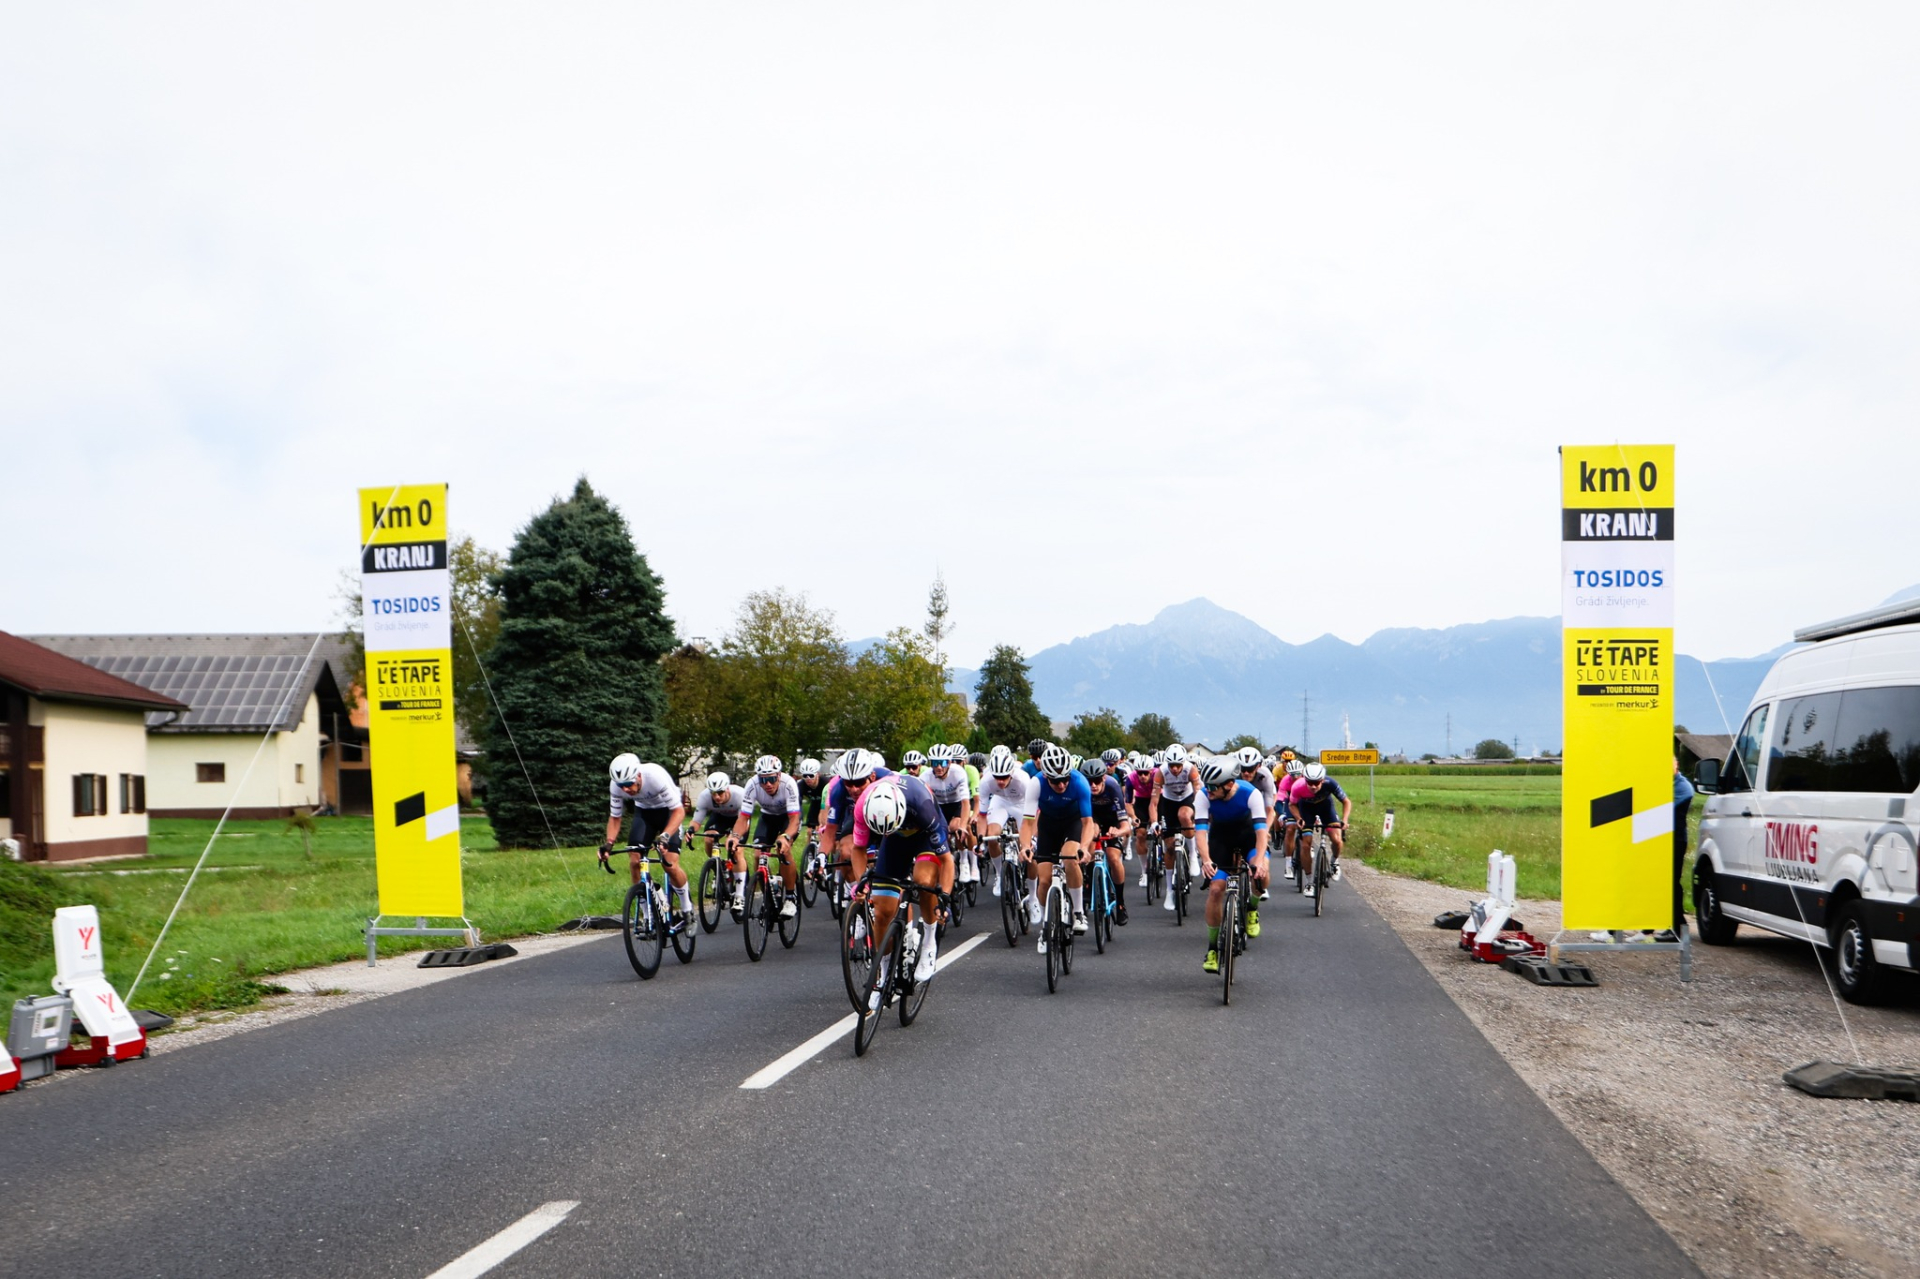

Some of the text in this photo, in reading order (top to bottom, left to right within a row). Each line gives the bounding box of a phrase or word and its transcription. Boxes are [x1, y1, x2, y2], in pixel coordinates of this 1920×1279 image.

[1580, 461, 1657, 492] km 0
[372, 499, 432, 529] km 0
[1580, 513, 1657, 537] KRANJ
[374, 545, 435, 570] KRANJ
[1573, 570, 1663, 587] TOSIDOS
[371, 596, 441, 614] TOSIDOS
[1577, 669, 1659, 681] SLOVENIA
[378, 685, 441, 698] SLOVENIA
[1606, 686, 1623, 694] TOUR
[1624, 686, 1632, 694] DE
[1633, 686, 1657, 694] FRANCE
[1327, 753, 1371, 763] Srednje Bitnje
[1765, 822, 1818, 864] TIMING
